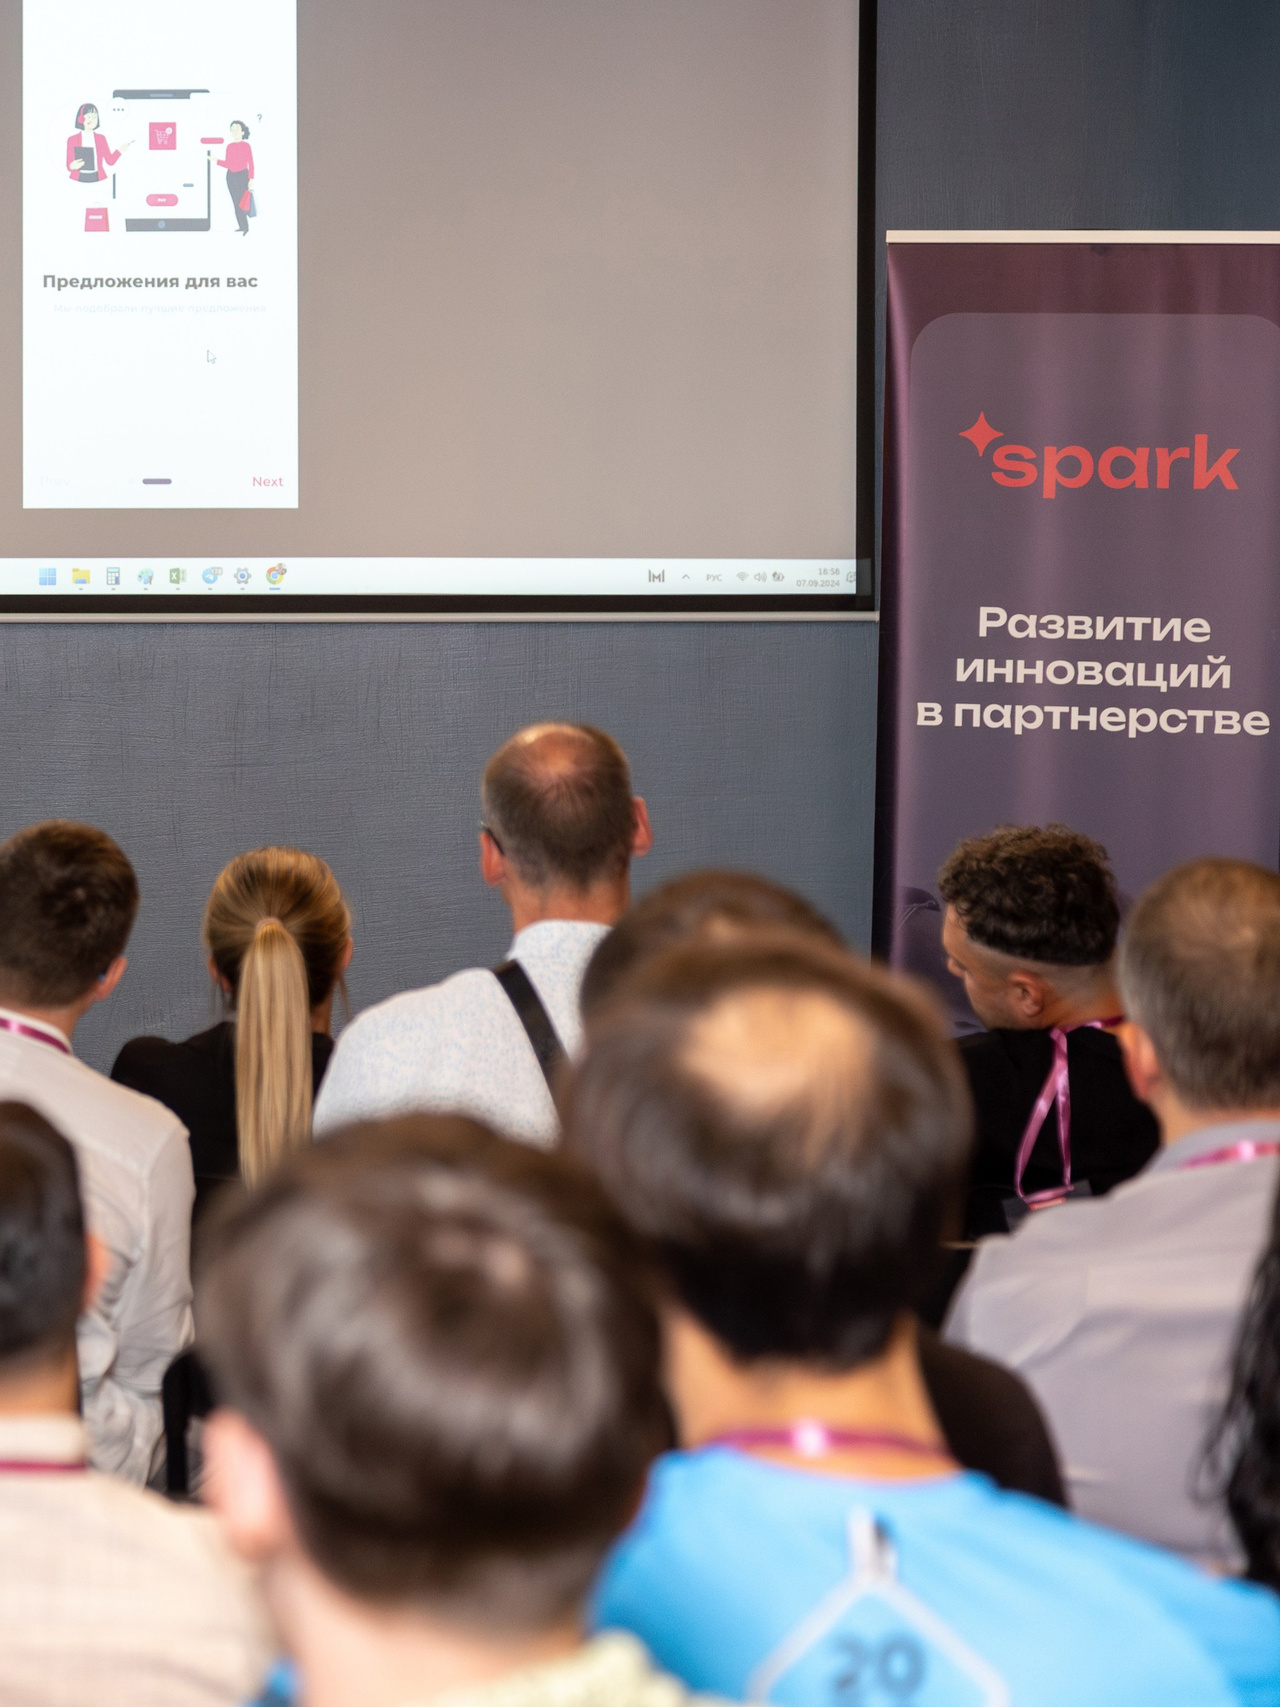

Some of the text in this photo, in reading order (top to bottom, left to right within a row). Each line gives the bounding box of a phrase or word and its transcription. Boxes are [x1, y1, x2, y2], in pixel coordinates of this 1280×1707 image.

[42, 274, 258, 291] Предложения для вас
[53, 304, 267, 314] Мы подобрали лучшие предложения
[991, 433, 1241, 499] spark
[252, 476, 284, 487] Next
[796, 579, 840, 588] 07.09.2024
[978, 606, 1212, 643] Развитие
[956, 655, 1232, 693] инноваций
[916, 702, 1272, 739] в партнерстве
